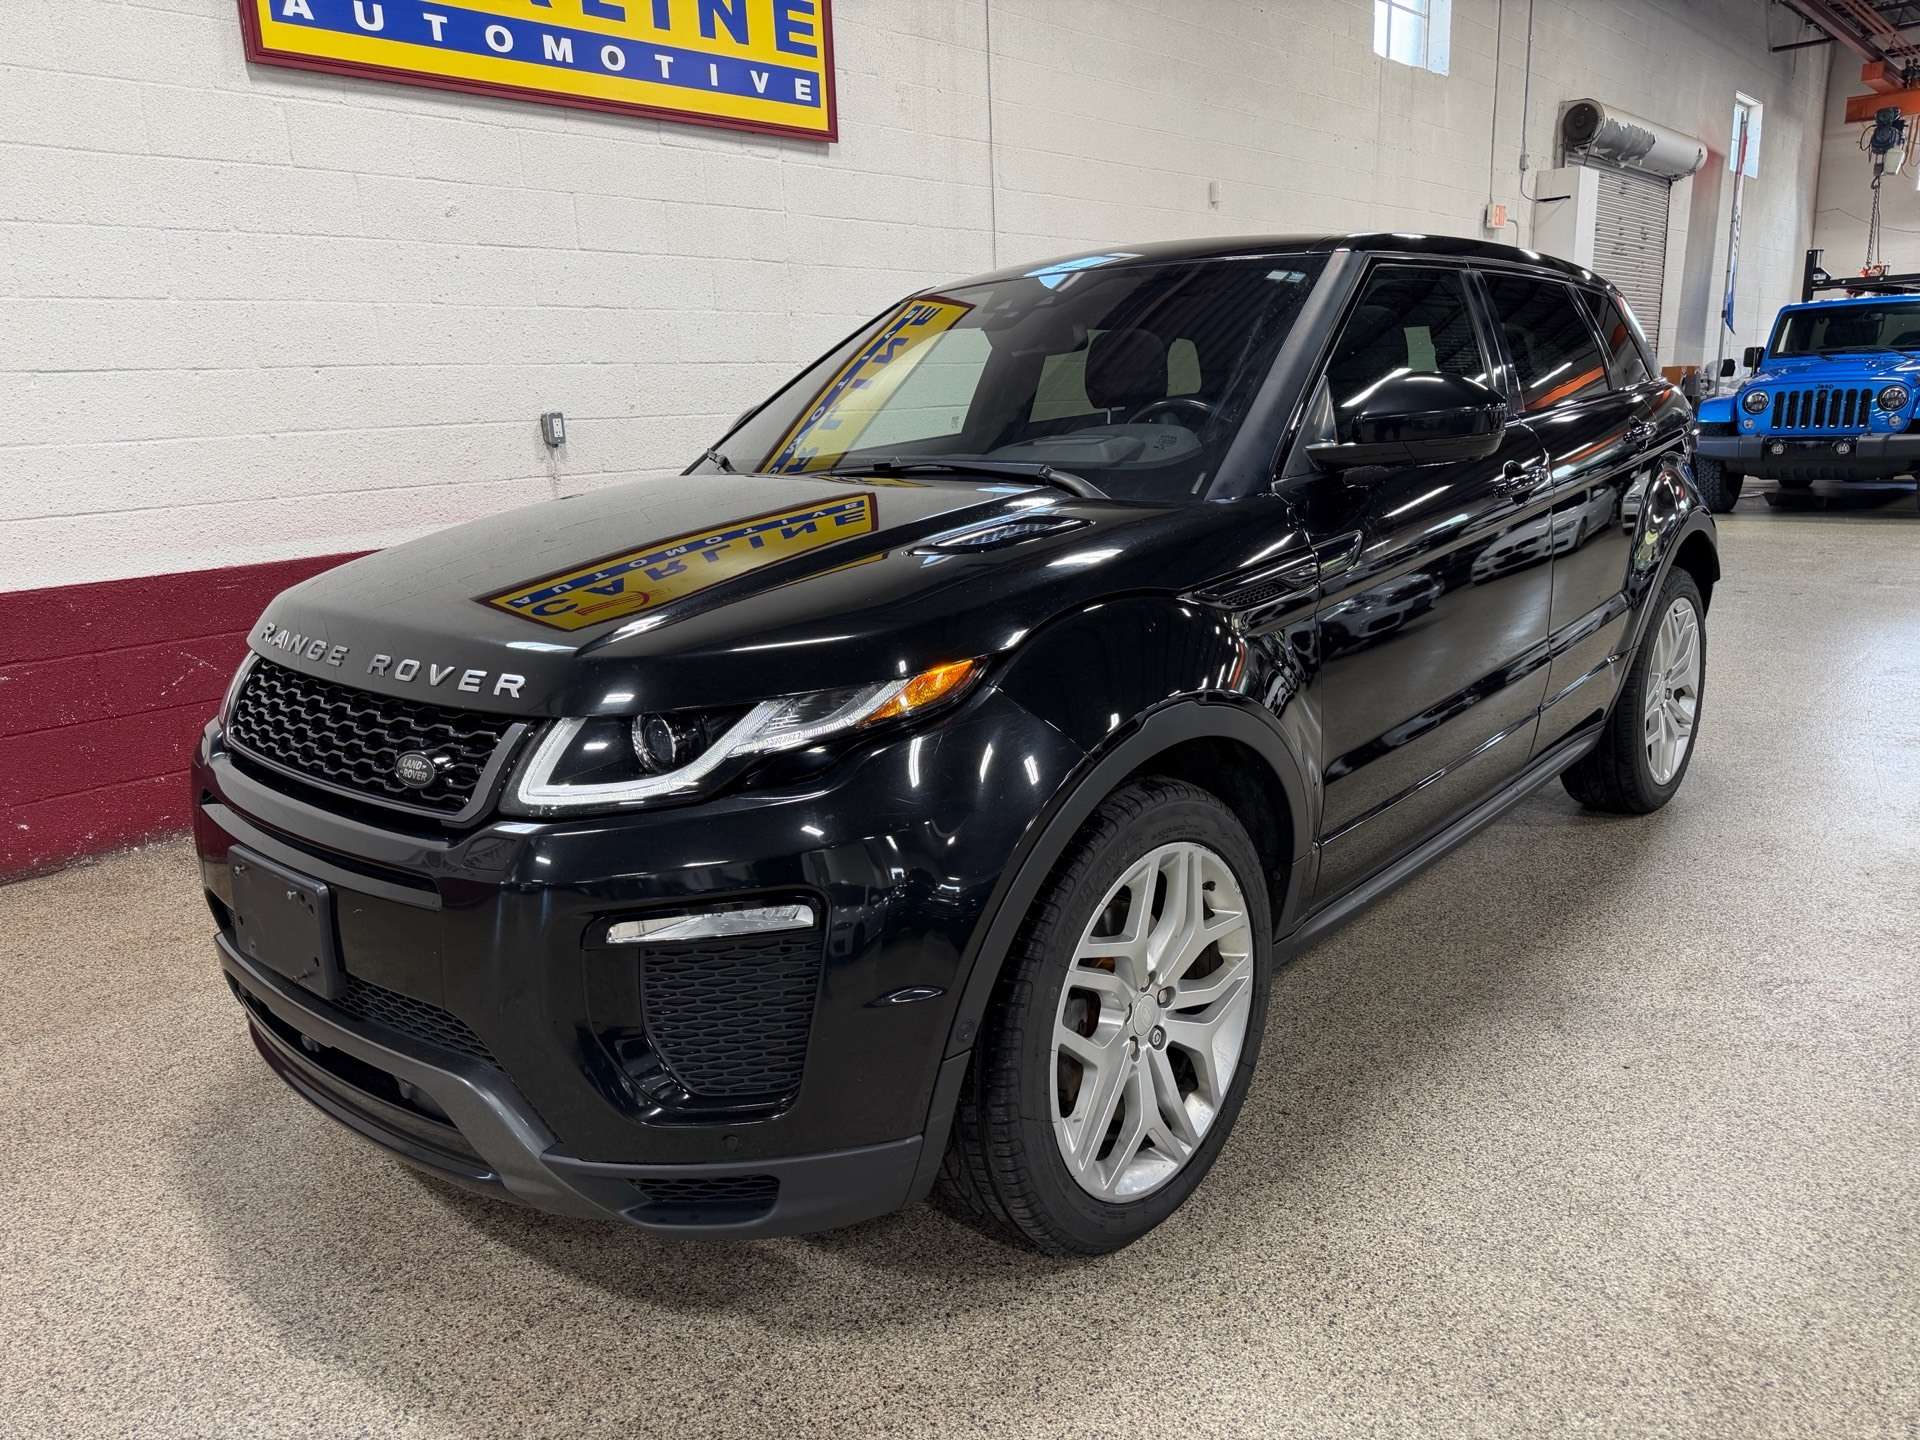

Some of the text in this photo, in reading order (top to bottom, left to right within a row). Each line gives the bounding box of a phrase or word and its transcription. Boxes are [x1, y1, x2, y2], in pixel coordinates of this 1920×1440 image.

[282, 0, 812, 101] AUTOMOTIVE
[260, 622, 527, 698] RANGE ROVER
